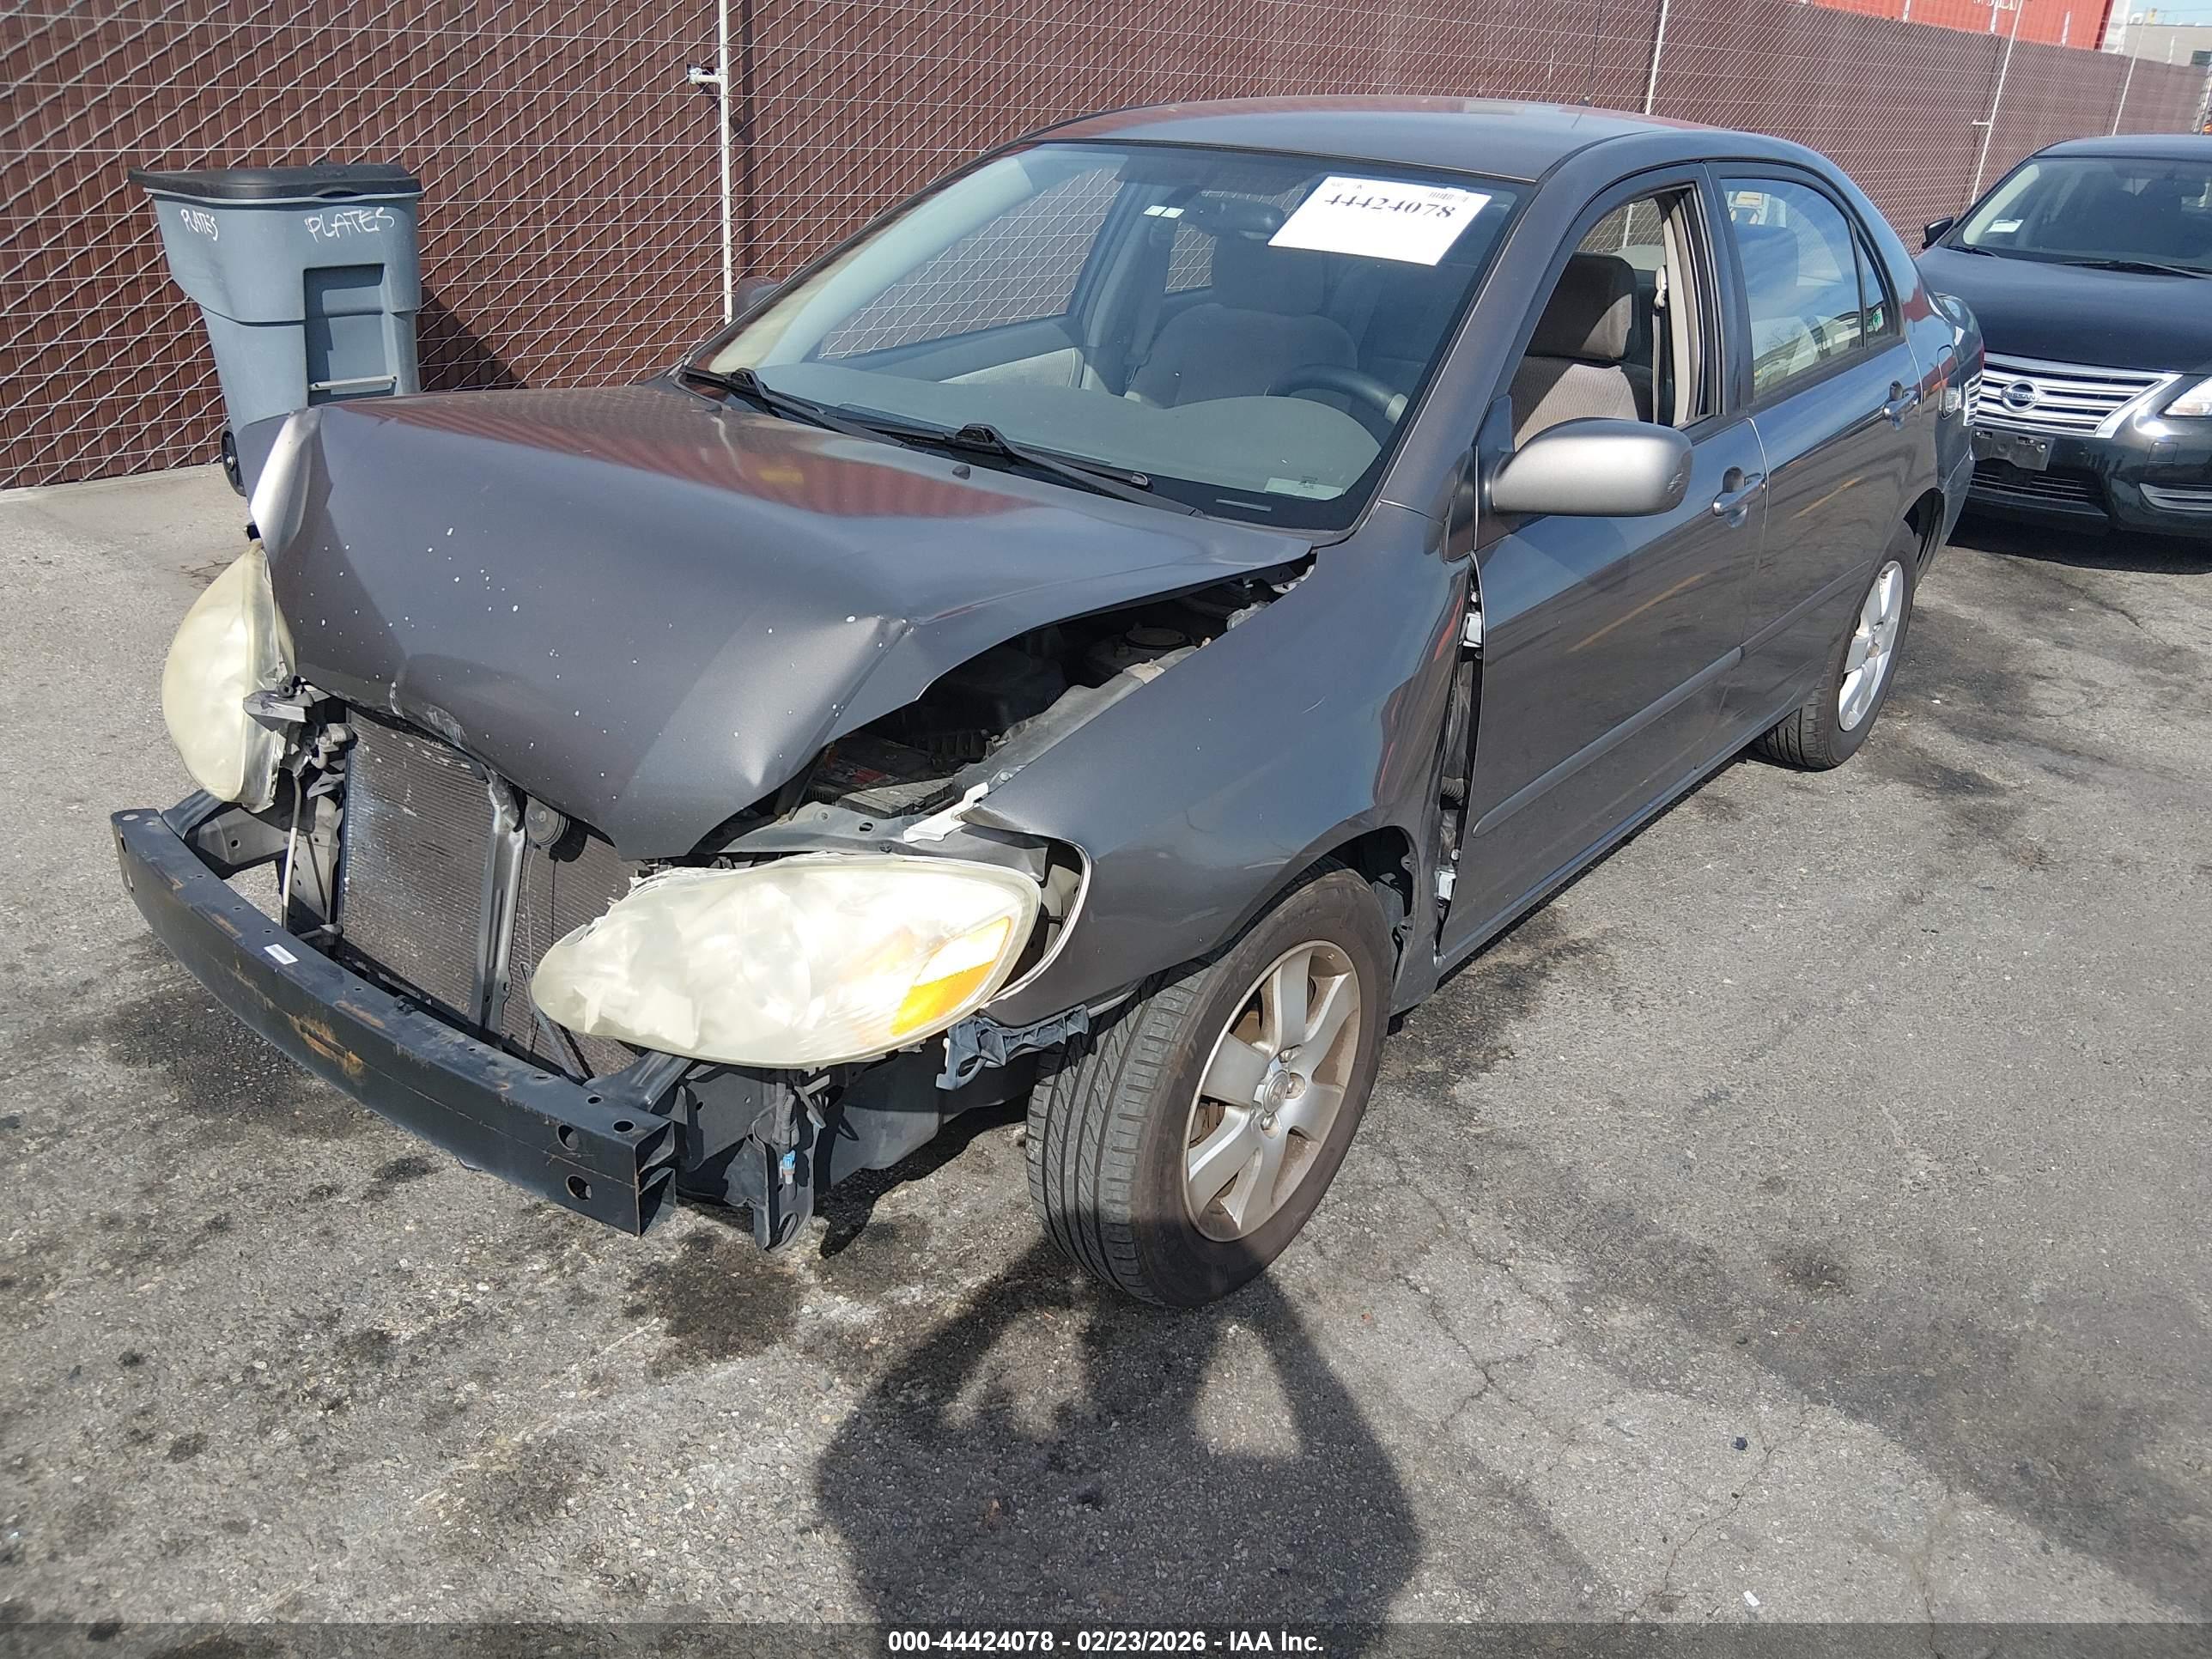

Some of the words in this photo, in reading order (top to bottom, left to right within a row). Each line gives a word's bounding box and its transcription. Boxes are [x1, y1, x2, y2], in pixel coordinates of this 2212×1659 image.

[1324, 193, 1456, 218] 44424078
[304, 207, 395, 243] PLATES
[2004, 391, 2036, 401] NISSAN
